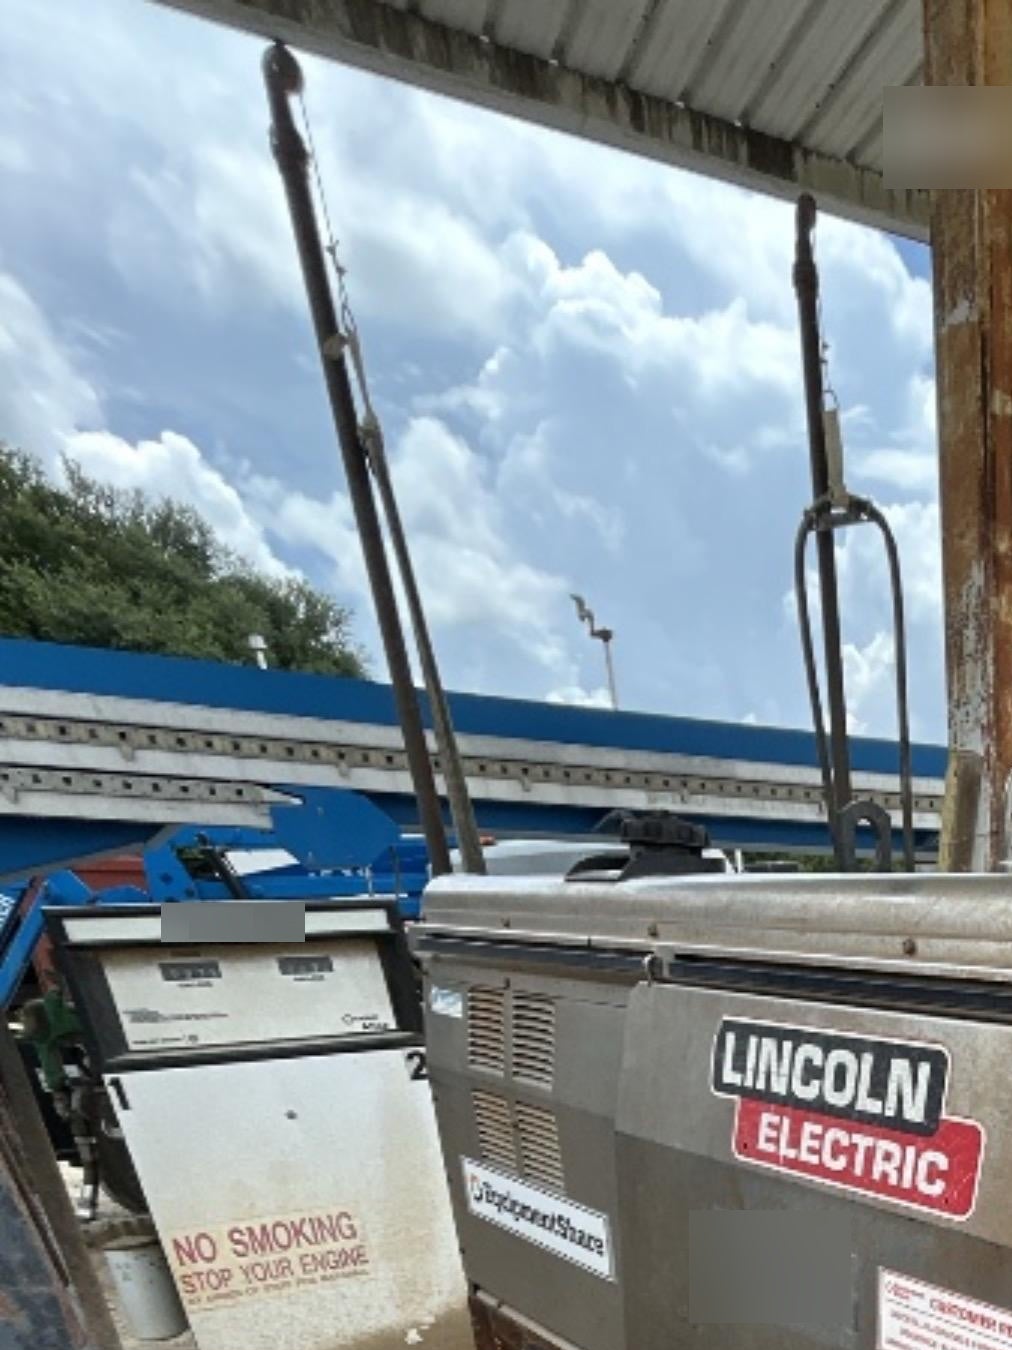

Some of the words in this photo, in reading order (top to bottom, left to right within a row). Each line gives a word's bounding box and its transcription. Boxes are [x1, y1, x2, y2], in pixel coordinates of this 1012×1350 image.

[406, 1050, 433, 1080] 2
[721, 1031, 931, 1123] LINCOLN
[756, 1112, 949, 1197] ELECTRIC
[172, 1231, 217, 1266] NO
[228, 1211, 358, 1257] SMOKING
[482, 1181, 604, 1256] EquipmentShare
[180, 1268, 232, 1294] STOP
[239, 1256, 294, 1284] YOUR
[299, 1244, 370, 1274] ENGINE
